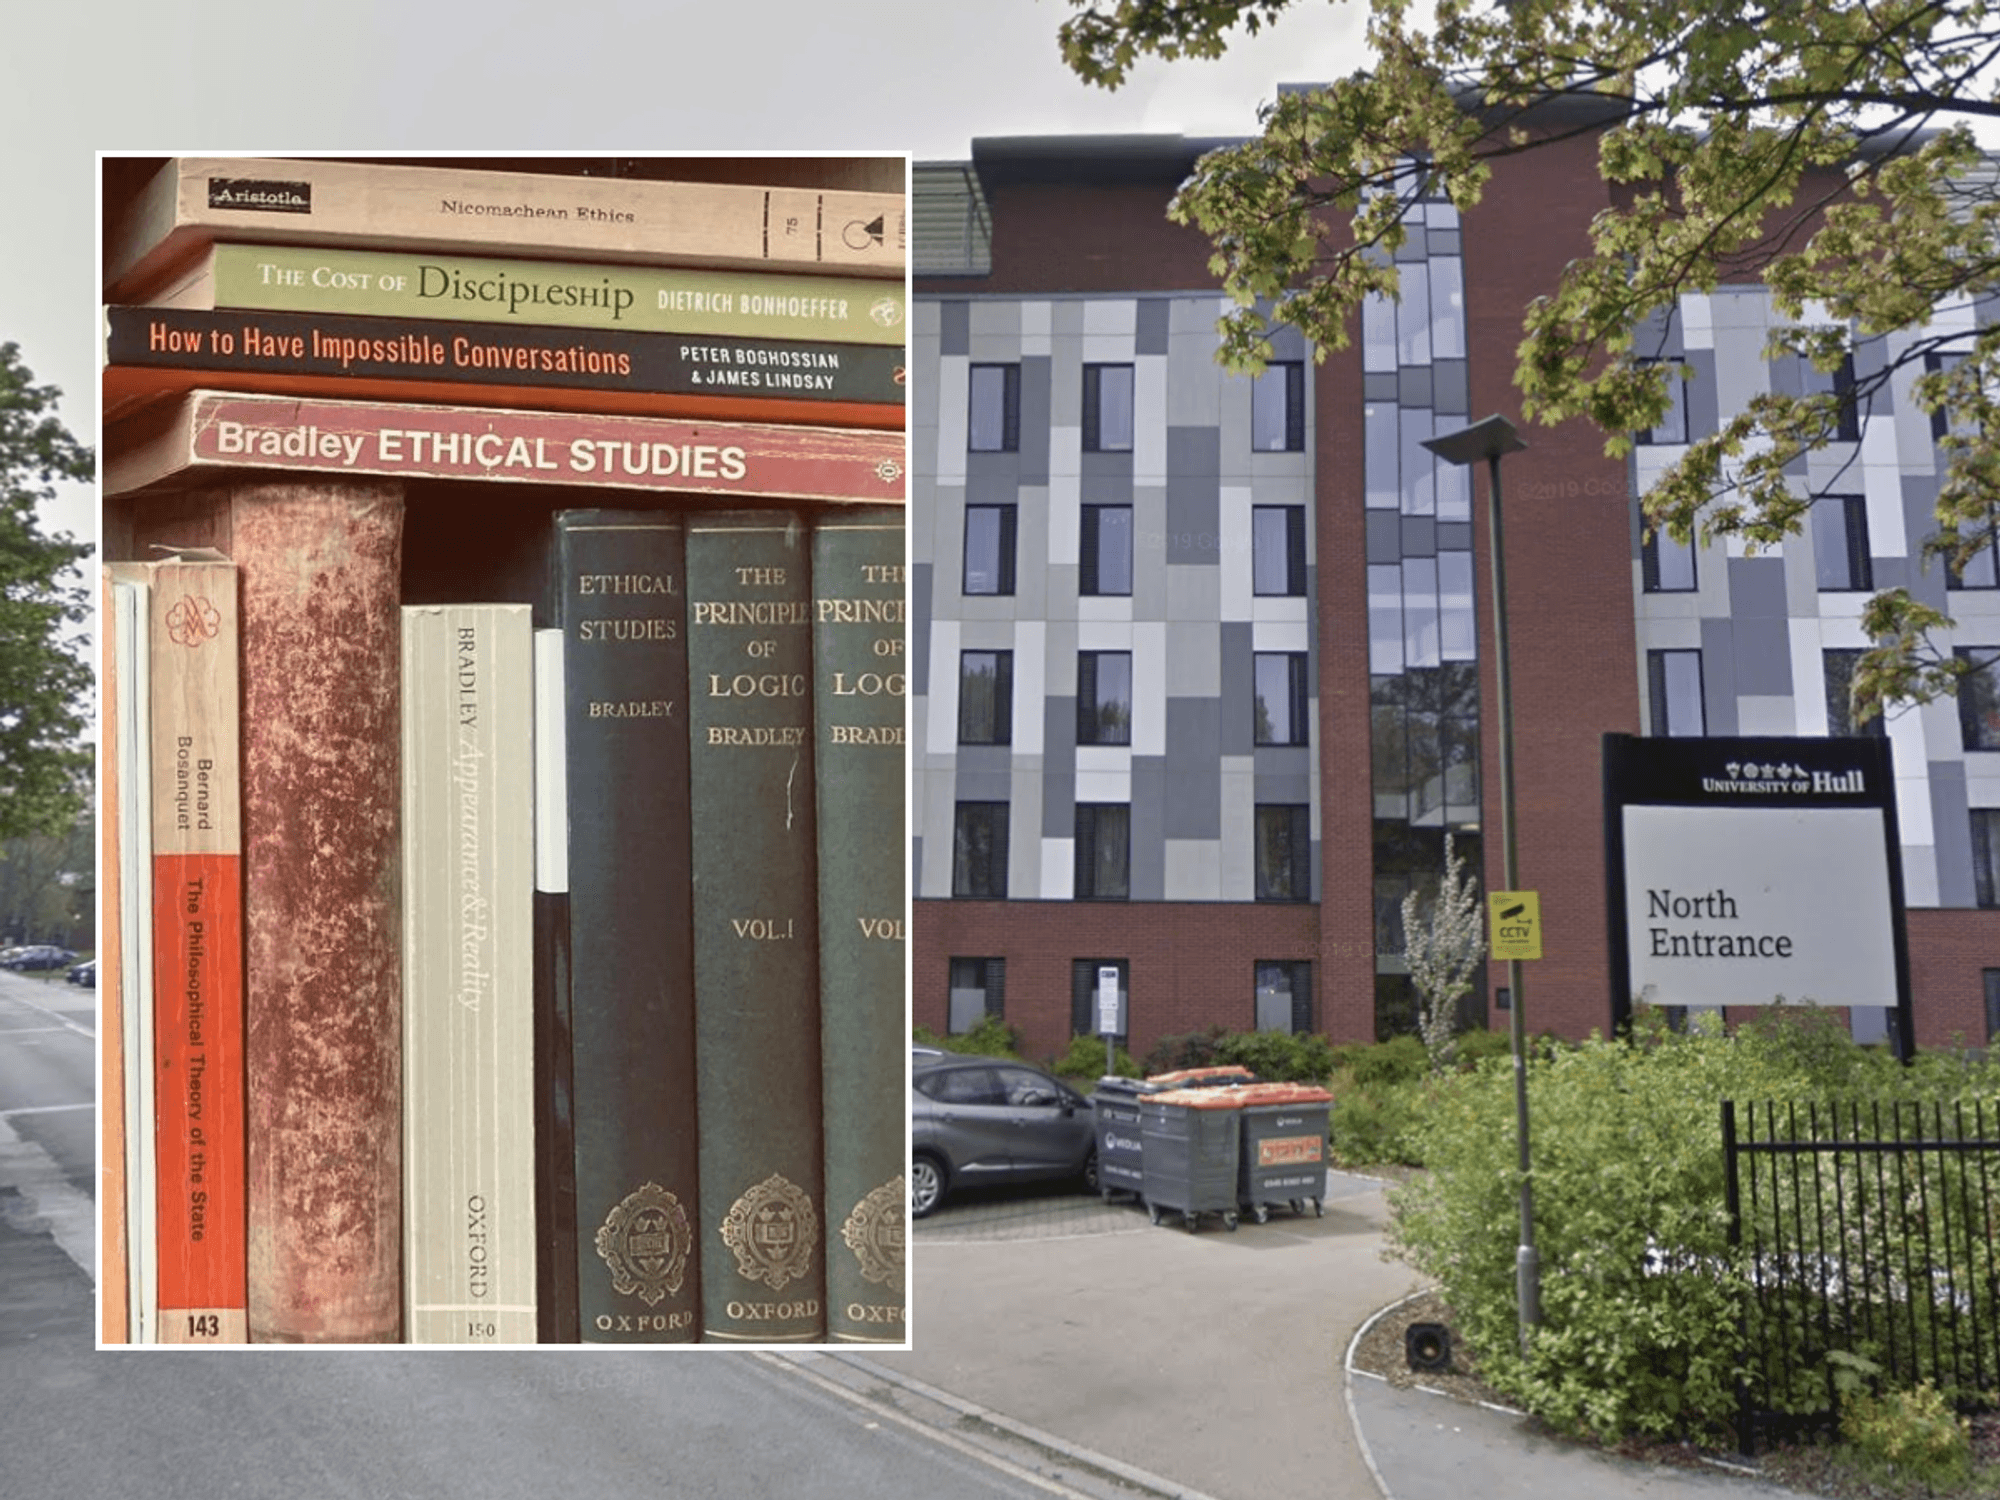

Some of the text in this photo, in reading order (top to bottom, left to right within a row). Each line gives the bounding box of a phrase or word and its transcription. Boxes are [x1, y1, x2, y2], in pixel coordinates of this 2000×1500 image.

[214, 188, 306, 205] Aristotle
[441, 200, 635, 224] Nicomachean Ethics
[786, 217, 799, 235] 75
[257, 263, 635, 320] THE COST OF Discipleship
[658, 289, 848, 319] DIETRICH BONHOEFFER
[150, 322, 631, 376] How to Have Impossible Conversations
[680, 346, 839, 369] PETER BOGHOSSIAN
[692, 370, 835, 390] & JAMES LINDSAY
[217, 421, 746, 480] Bradley ETHICAL STUDIES
[579, 575, 677, 595] ETHICAL
[735, 567, 786, 585] THE
[579, 619, 676, 640] STUDIES
[747, 640, 777, 657] OF
[874, 638, 904, 657] OF
[458, 627, 477, 729] BRADLEY
[708, 674, 804, 697] LOGIC
[832, 673, 905, 696] LOG
[589, 701, 673, 717] BRADLEY
[707, 727, 805, 745] BRADLEY
[177, 735, 193, 831] Bosanquet
[1702, 771, 1865, 793] UNIVERSITY OF Hull
[197, 758, 213, 831] Bernard
[1647, 889, 1739, 919] North
[1499, 926, 1530, 938] CCTV
[1649, 927, 1793, 958] Entrance
[186, 879, 208, 1243] The Philosophical Theory of the State
[468, 1194, 488, 1299] OXFORD
[596, 1309, 692, 1333] OXFORD
[726, 1300, 819, 1321] OXFORD
[187, 1314, 219, 1337] 143
[468, 1322, 496, 1338] 150
